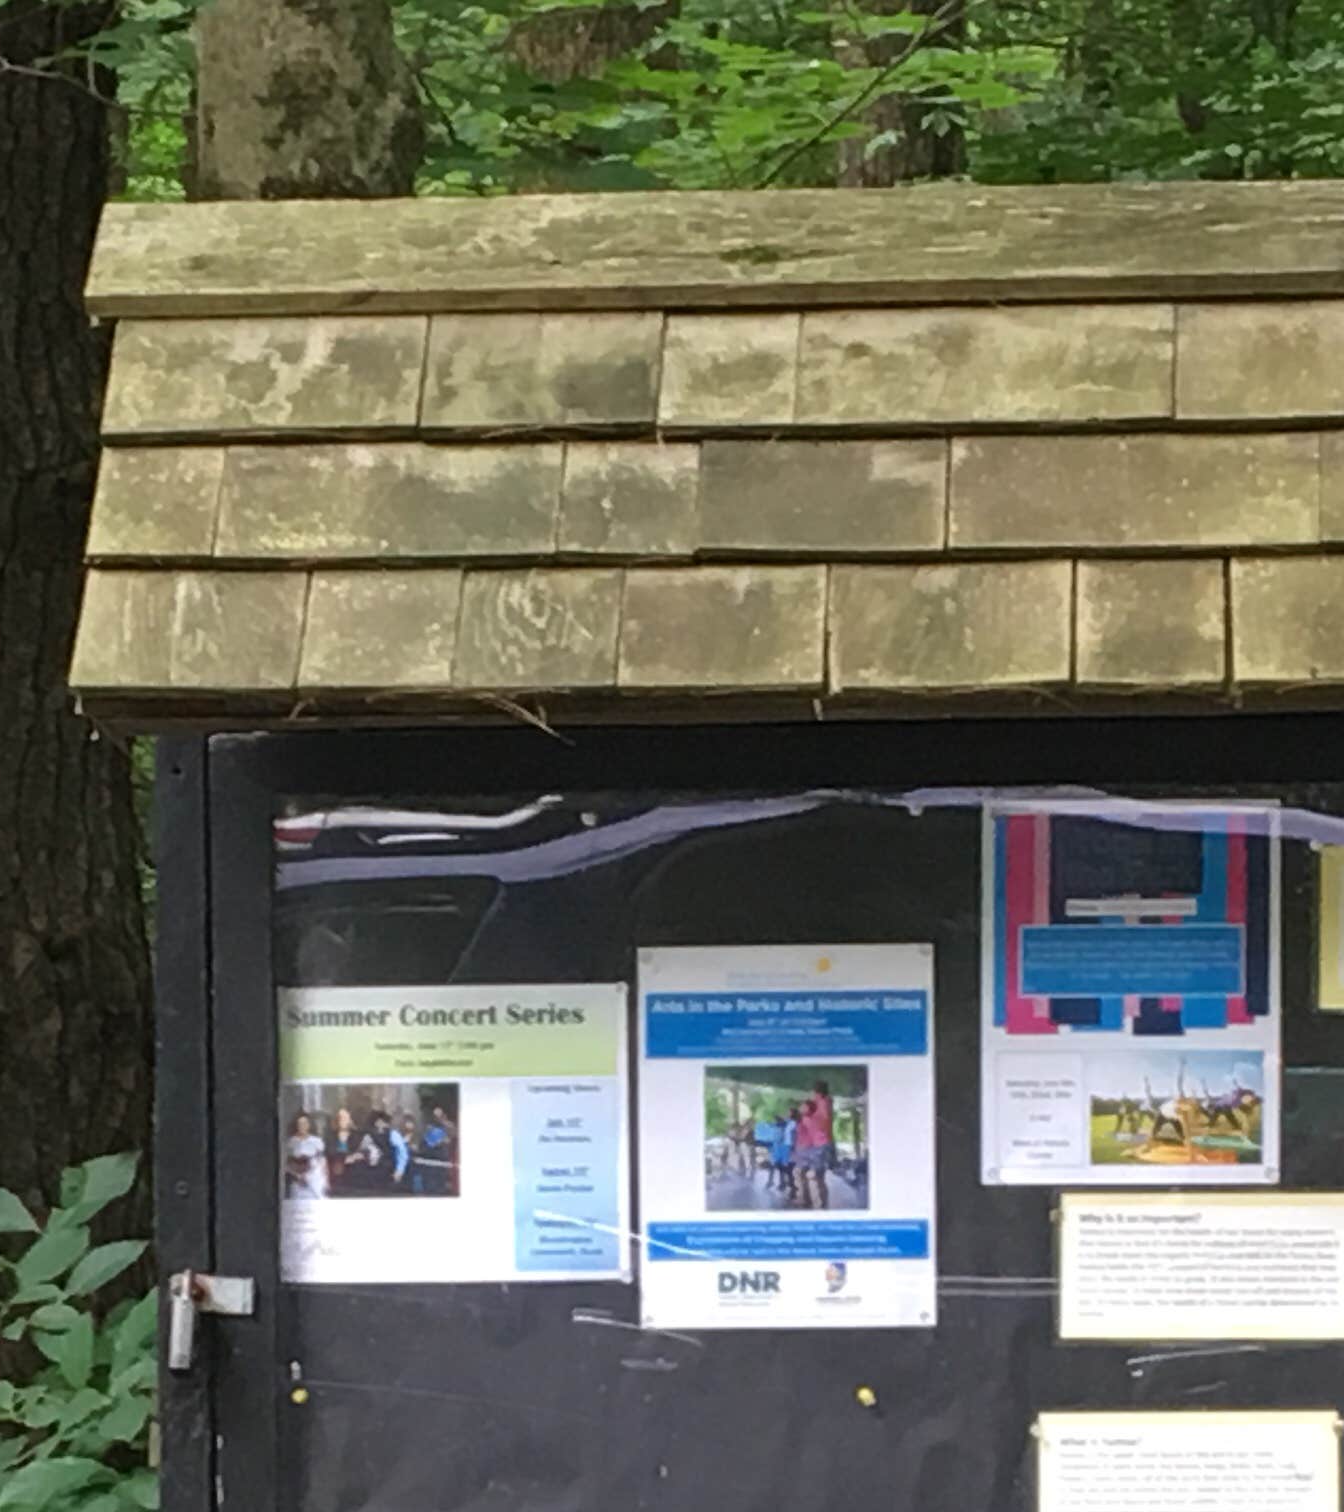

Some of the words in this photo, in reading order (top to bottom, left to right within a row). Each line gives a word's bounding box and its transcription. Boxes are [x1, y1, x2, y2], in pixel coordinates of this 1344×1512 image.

[287, 1006, 391, 1029] Summer
[399, 1003, 498, 1027] Concert
[506, 1001, 585, 1026] Series
[707, 999, 733, 1013] the
[718, 1271, 781, 1294] DNR
